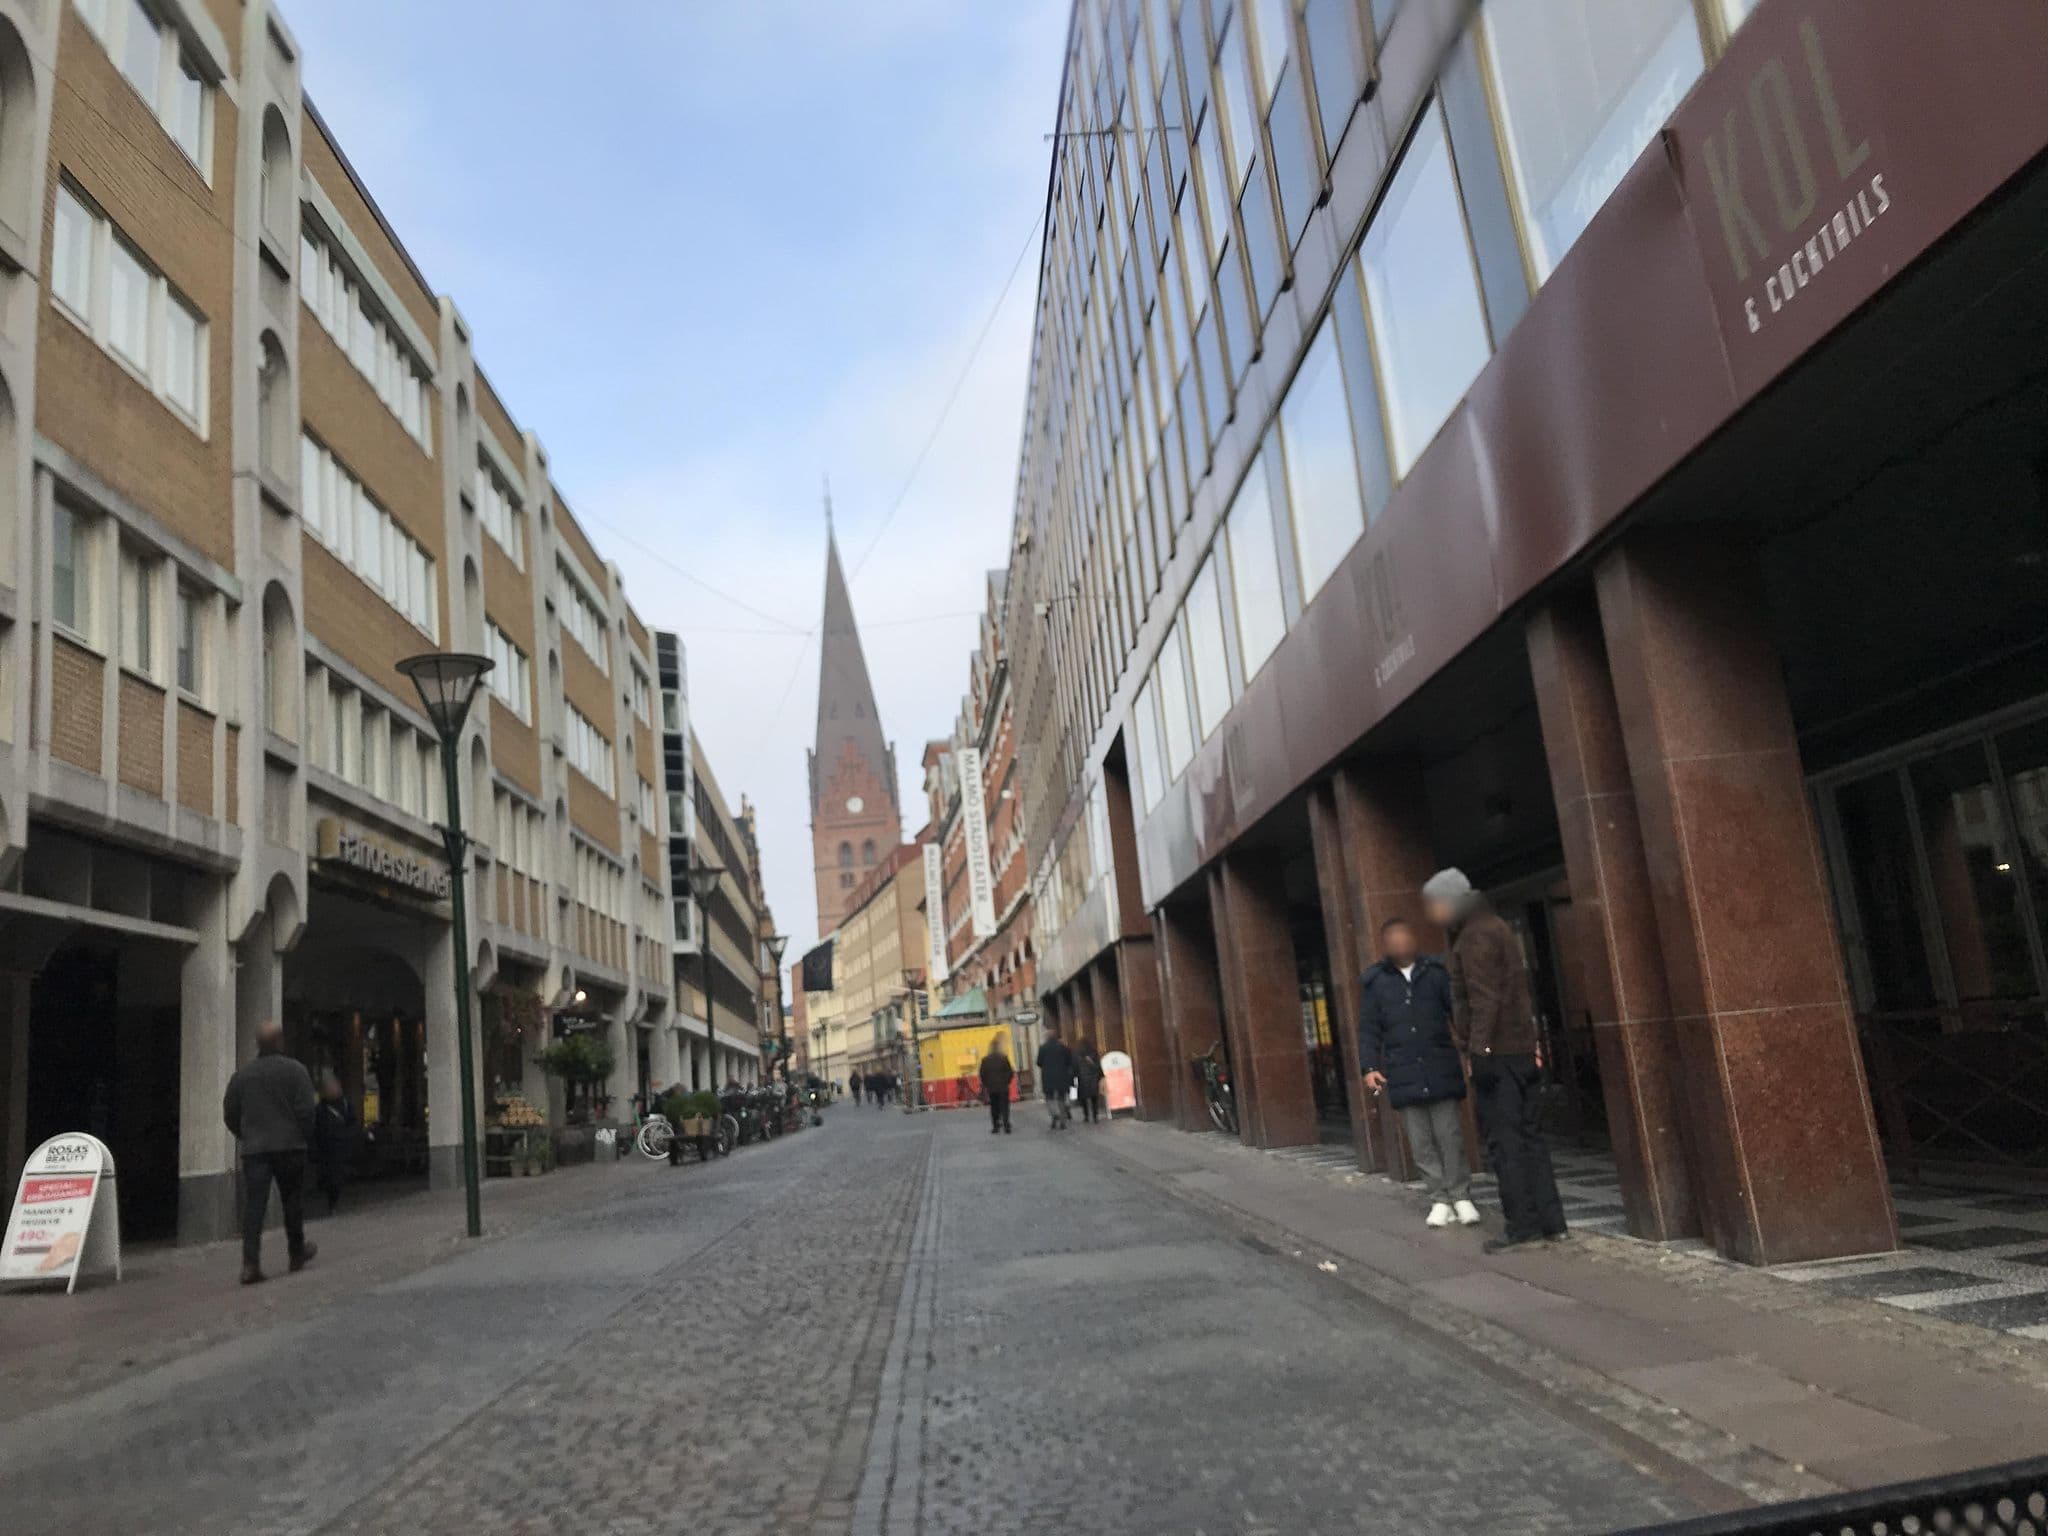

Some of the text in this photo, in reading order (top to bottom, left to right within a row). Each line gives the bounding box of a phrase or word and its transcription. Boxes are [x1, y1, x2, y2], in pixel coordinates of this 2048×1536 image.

[1704, 20, 1871, 282] KOL
[1765, 173, 1891, 313] COCKTAILS
[969, 808, 988, 903] STADSTEATER
